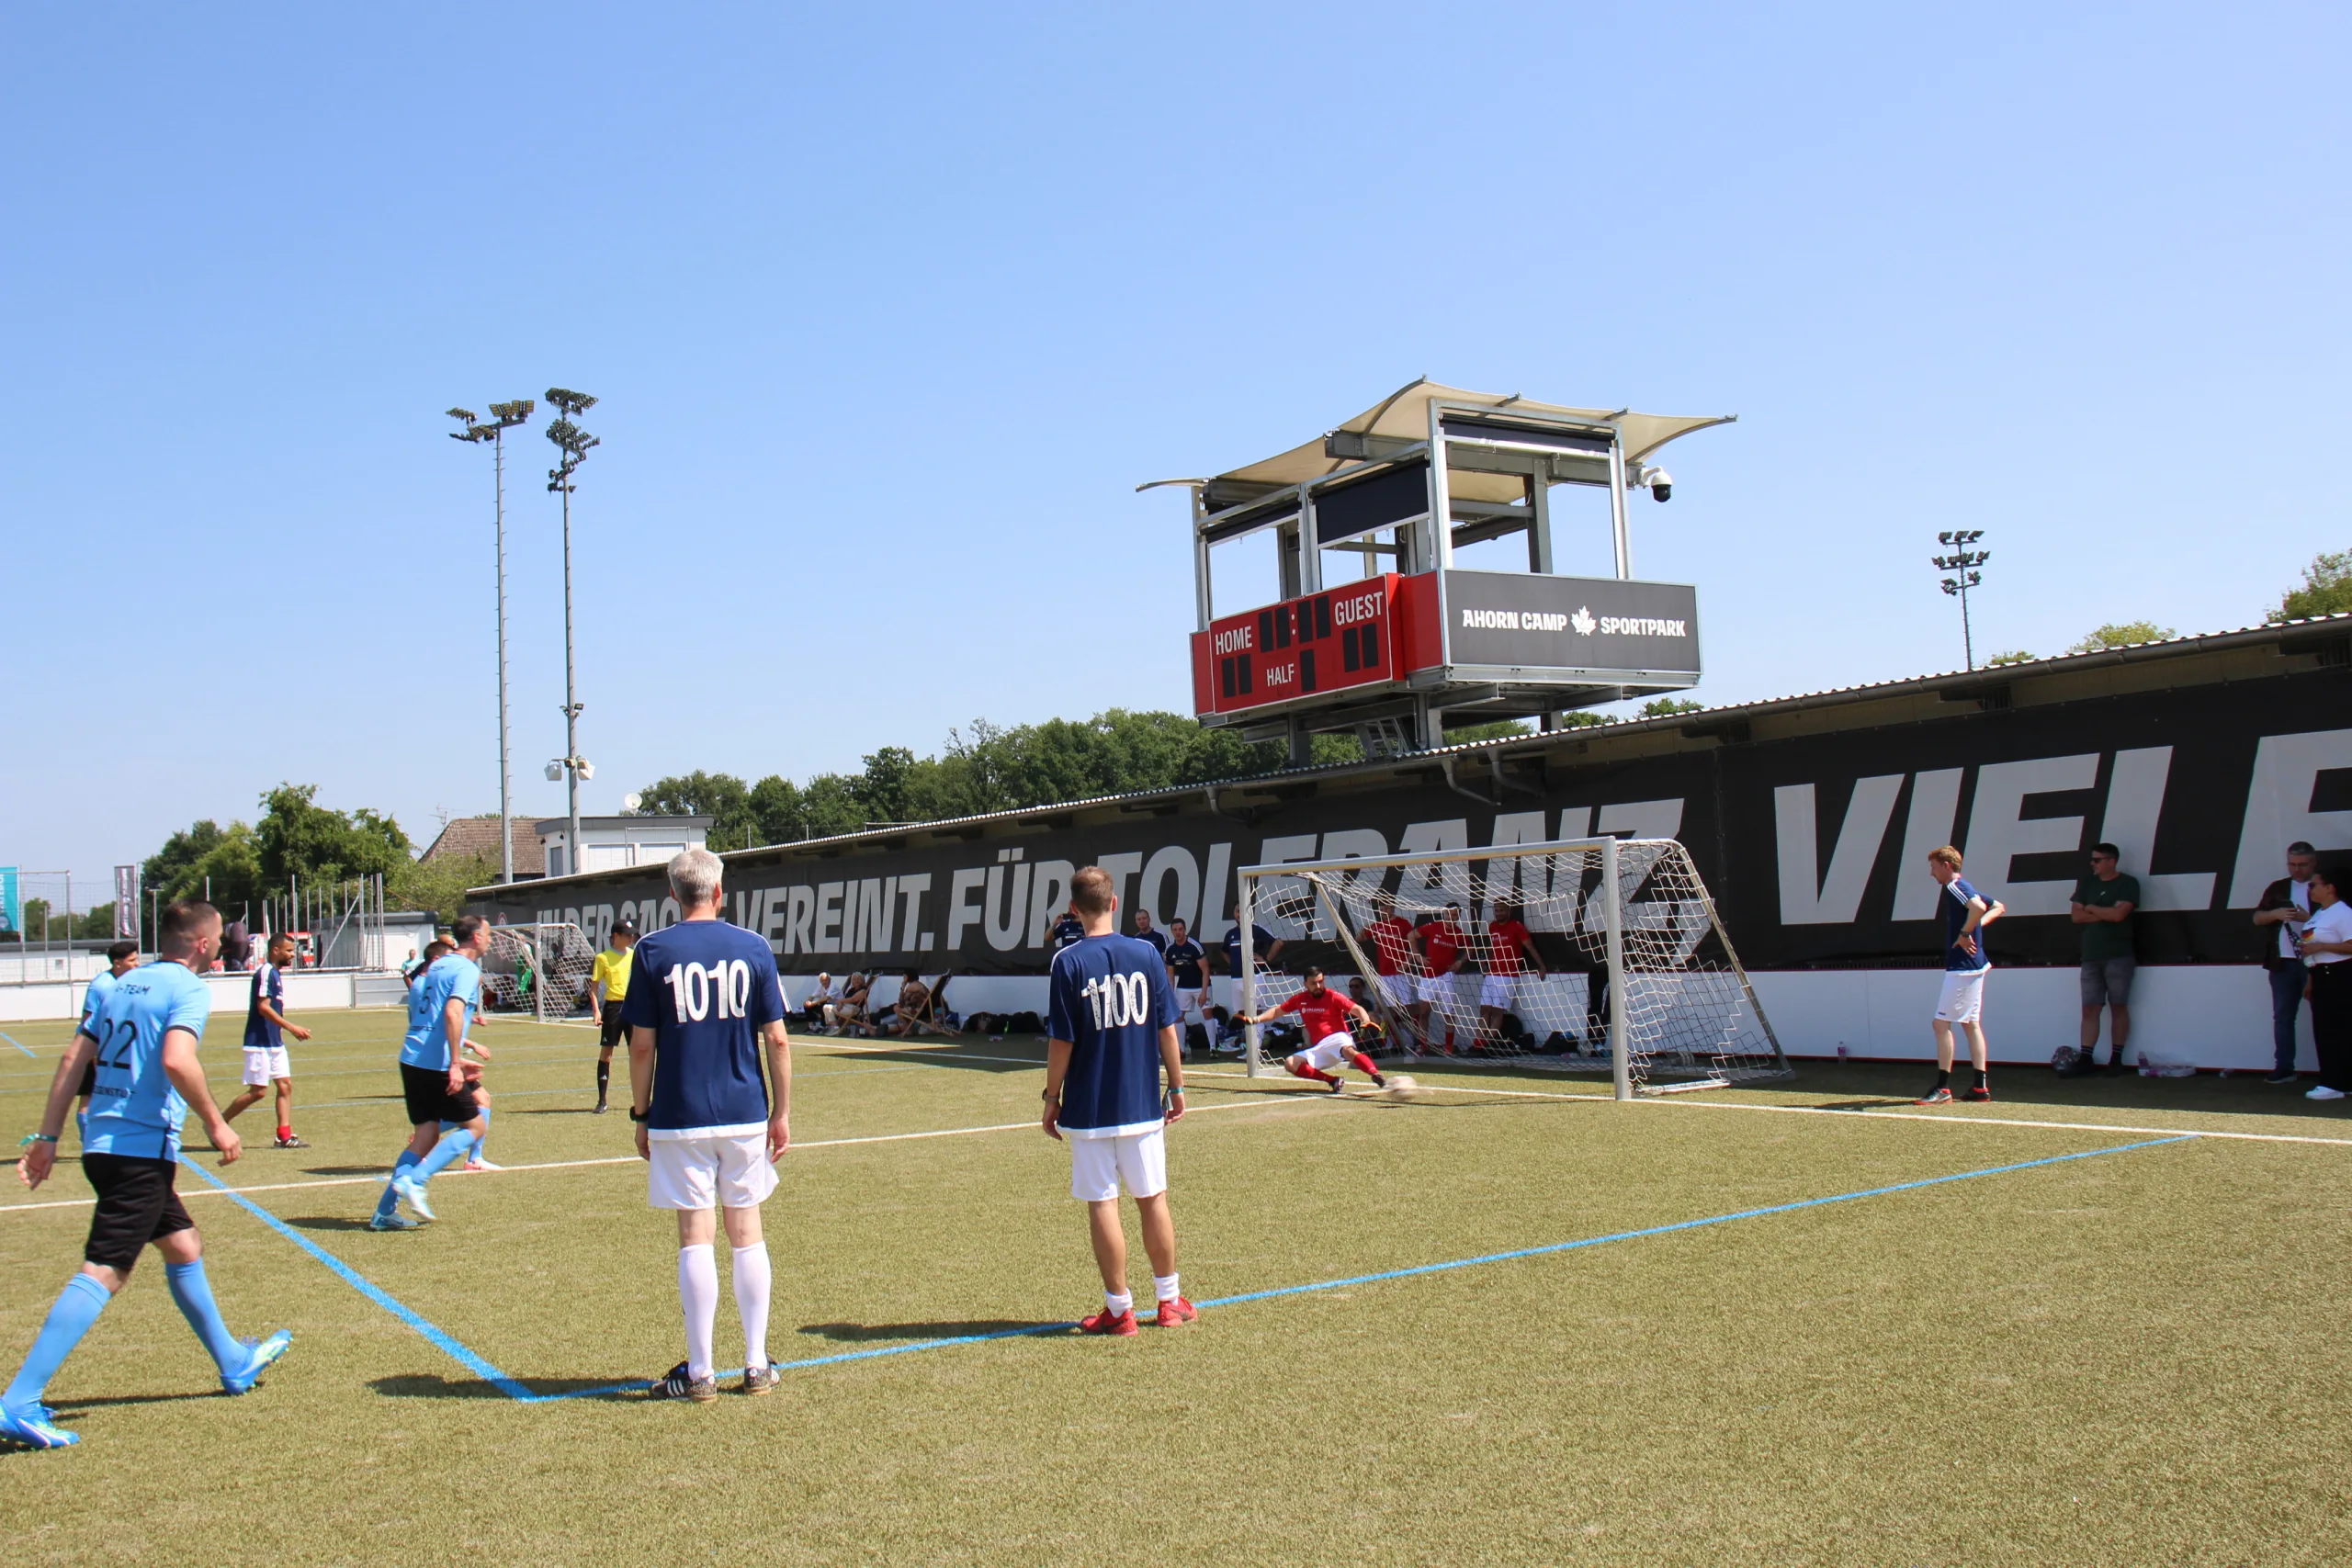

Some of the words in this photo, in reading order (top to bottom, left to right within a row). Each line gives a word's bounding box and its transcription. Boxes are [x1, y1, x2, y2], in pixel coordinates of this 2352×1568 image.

[1215, 626, 1253, 655] HOME
[1334, 591, 1384, 626] GUEST
[1462, 609, 1519, 629] AHORN
[1521, 612, 1567, 632] CAMP
[1600, 616, 1687, 637] SPORTPARK
[1266, 663, 1295, 687] HALF
[735, 873, 934, 954] VEREINT.
[947, 847, 1077, 952] FÜR
[663, 958, 751, 1023] 1010
[1080, 970, 1149, 1031] 1100
[96, 1017, 138, 1070] 22
